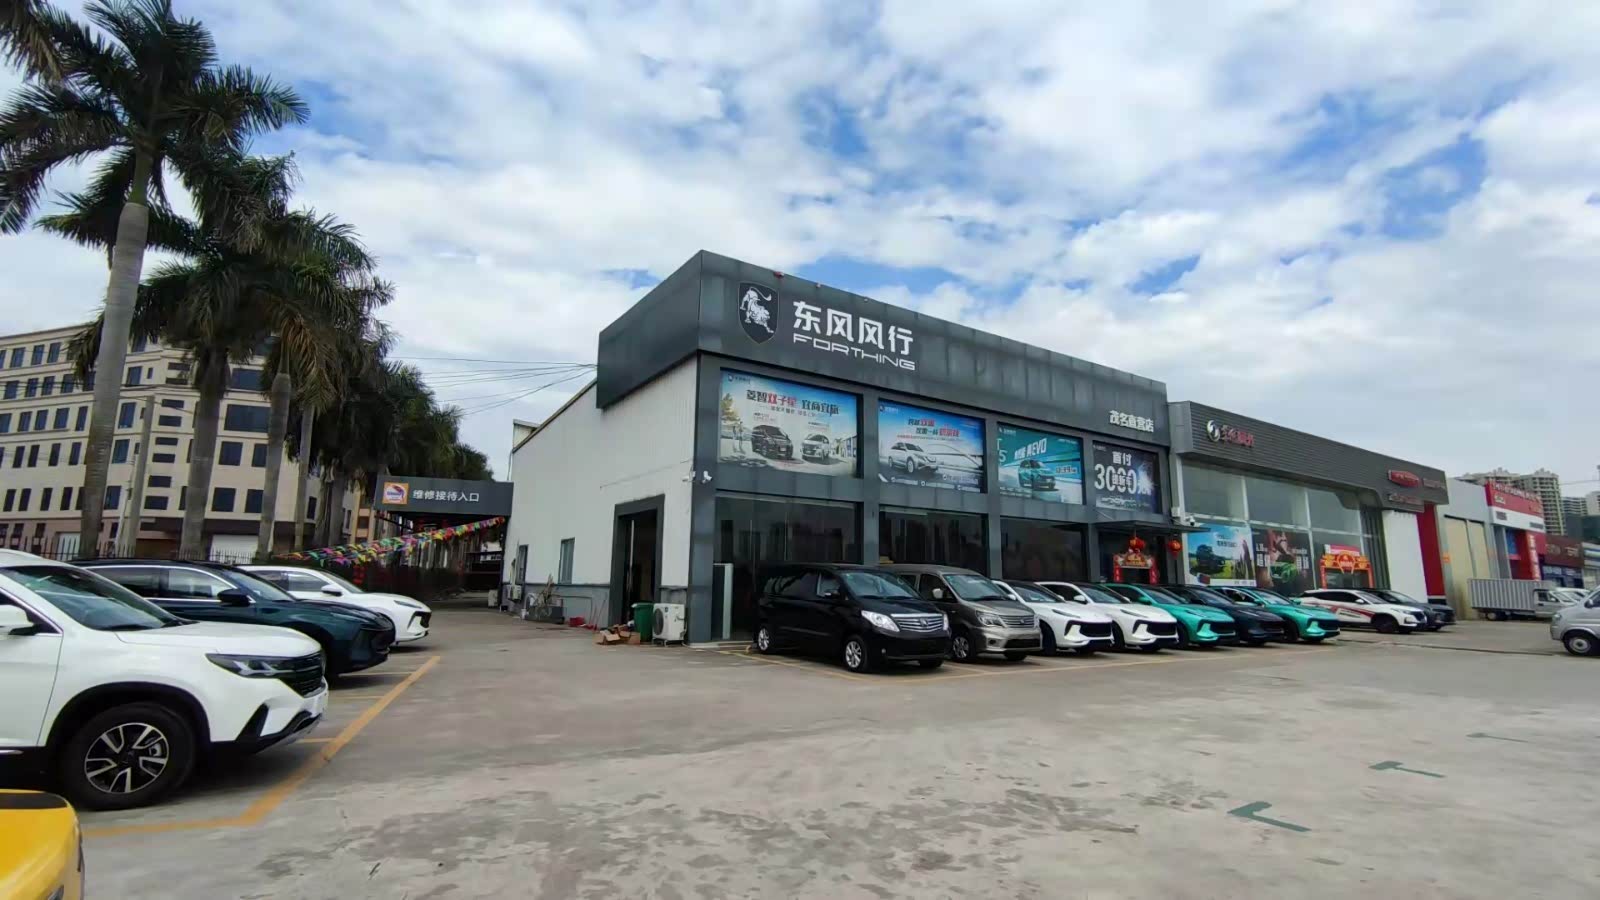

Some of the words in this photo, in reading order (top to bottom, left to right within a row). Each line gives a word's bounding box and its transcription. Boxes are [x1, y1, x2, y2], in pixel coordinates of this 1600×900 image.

[793, 301, 914, 355] 东风风行
[793, 332, 916, 371] FORTHING
[1109, 409, 1154, 433] 茂名直营店
[1112, 451, 1132, 467] 首付
[412, 489, 480, 502] 维修接待入口
